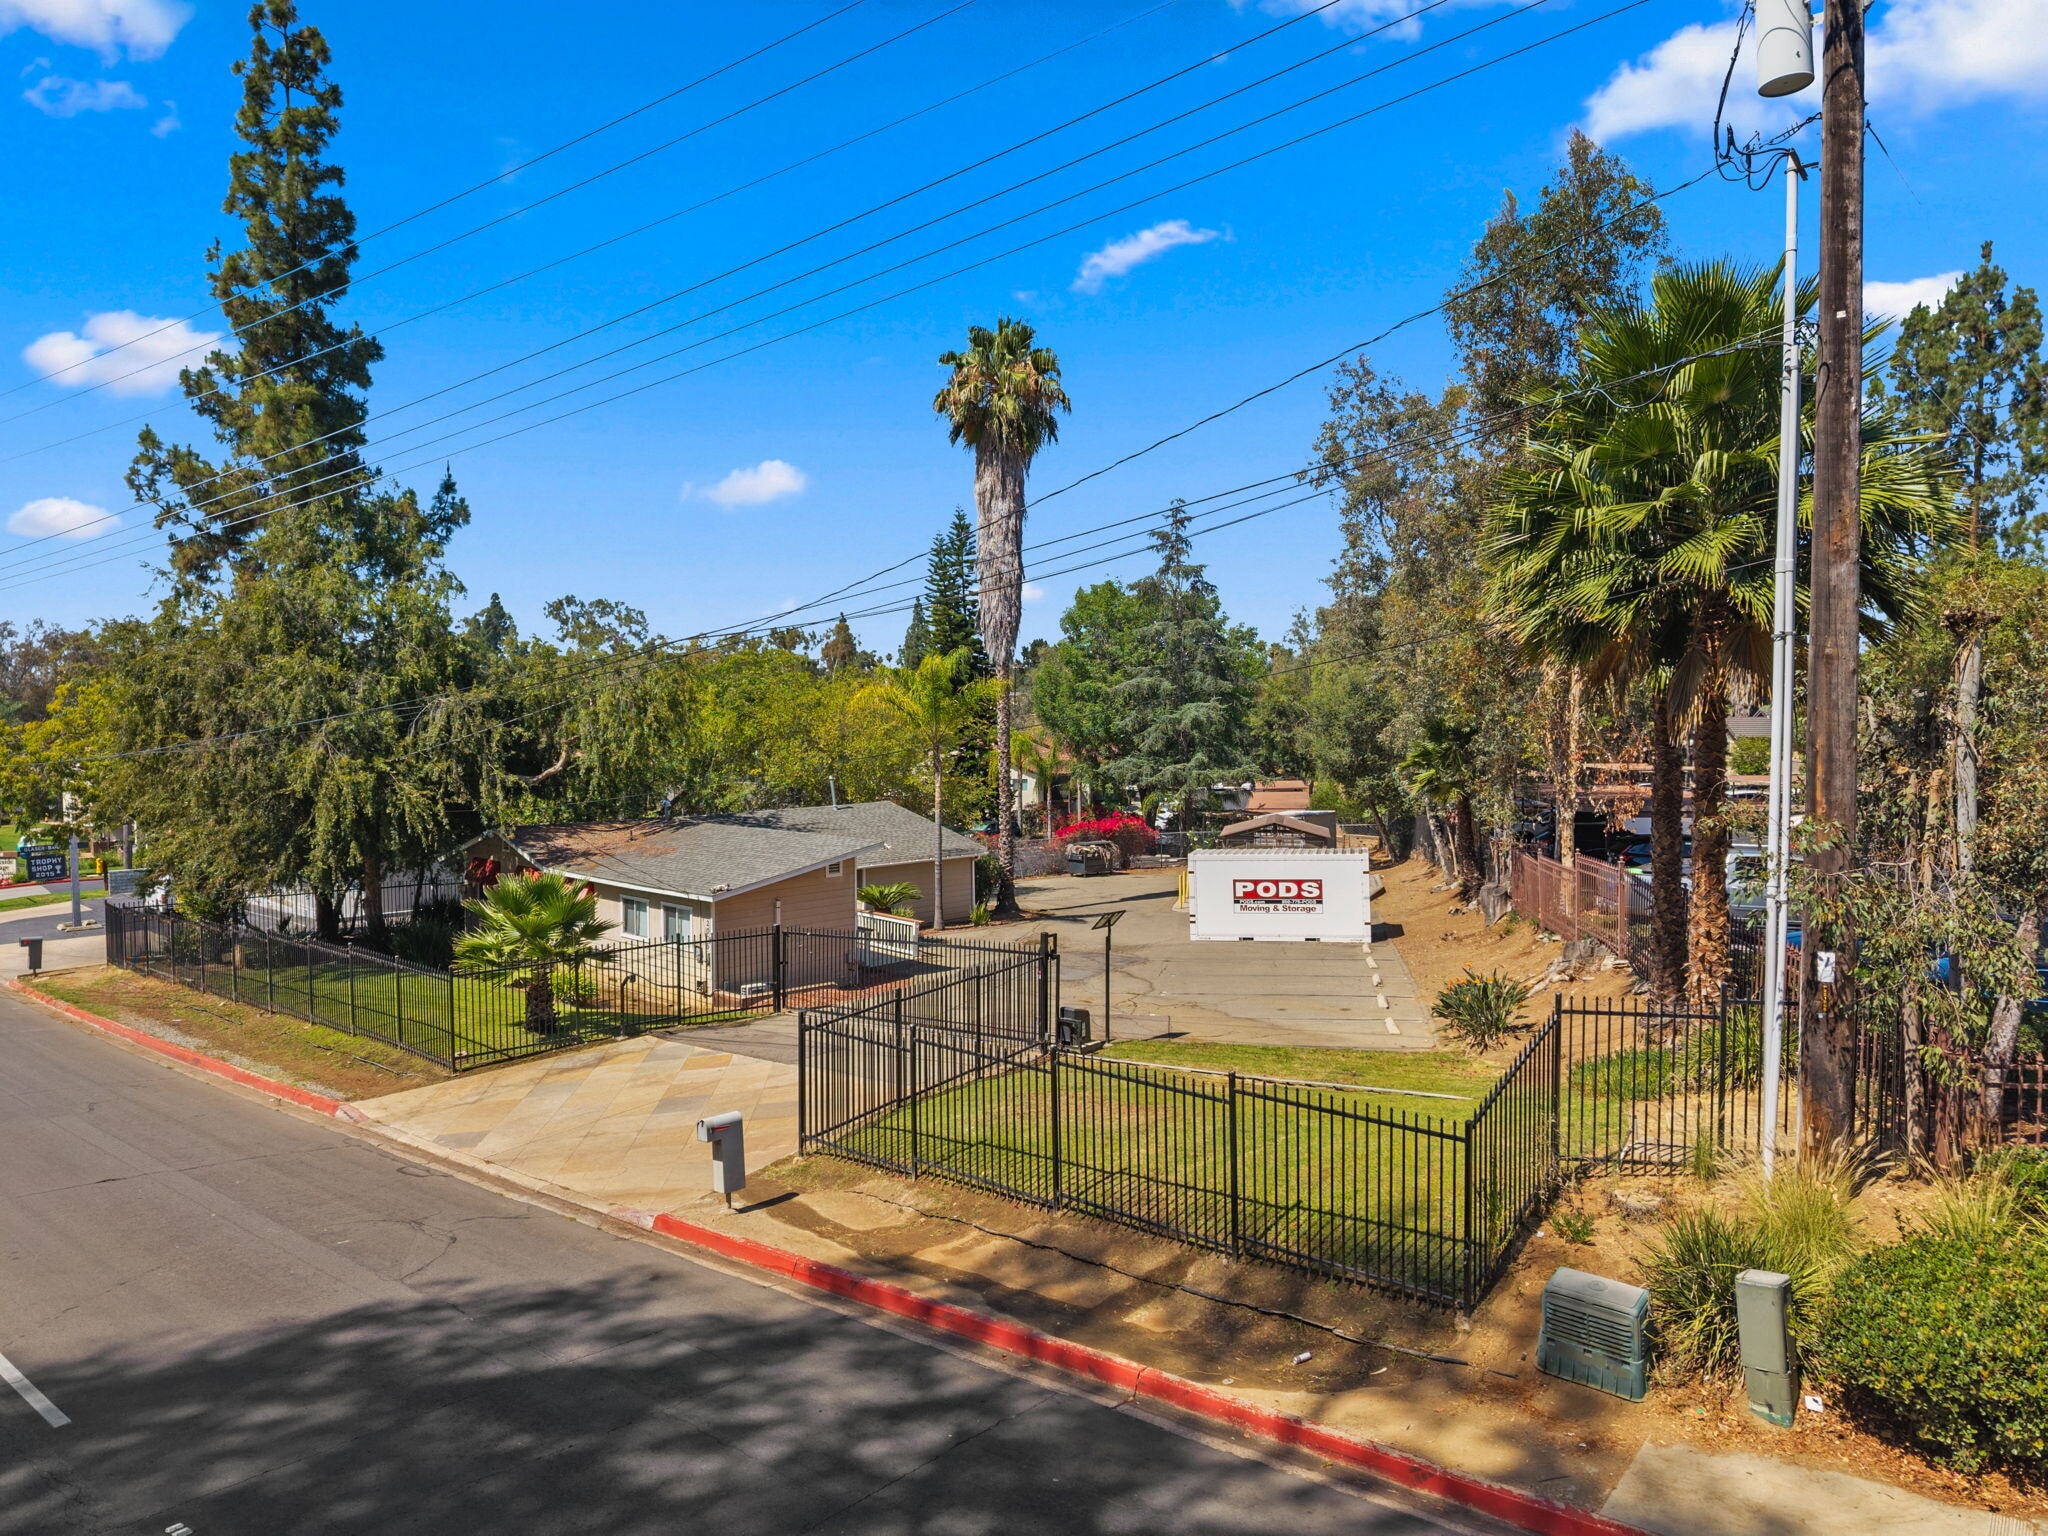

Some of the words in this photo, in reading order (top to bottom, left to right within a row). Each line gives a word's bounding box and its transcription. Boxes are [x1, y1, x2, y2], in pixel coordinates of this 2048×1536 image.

[31, 857, 62, 866] TROPHY
[31, 864, 53, 872] SHOP
[1235, 881, 1320, 897] PODS
[1240, 904, 1270, 913] Moving
[1272, 904, 1280, 912] &
[1282, 904, 1317, 913] Storage
